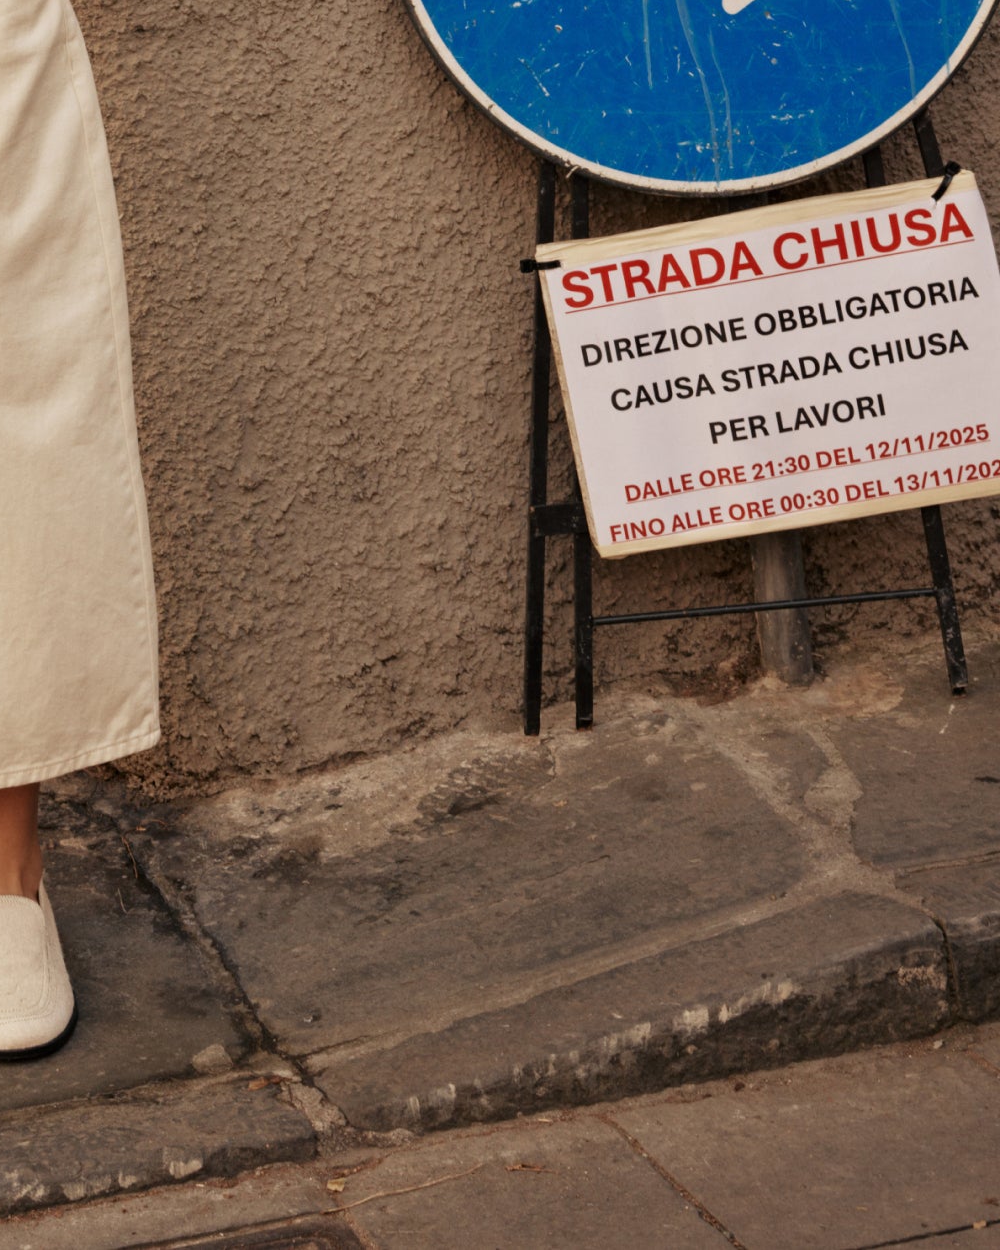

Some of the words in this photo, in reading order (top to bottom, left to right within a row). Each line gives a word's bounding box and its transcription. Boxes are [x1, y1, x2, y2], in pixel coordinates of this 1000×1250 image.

[562, 241, 763, 309] STRADA
[773, 203, 974, 271] CHIUSA
[581, 317, 747, 367] DIREZIONE
[754, 276, 980, 336] OBBLIGATORIA
[611, 373, 716, 412] CAUSA
[721, 352, 843, 393] STRADA
[848, 329, 969, 370] CHIUSA
[709, 415, 770, 445] PER
[775, 393, 886, 434] LAVORI
[624, 473, 695, 503] DALLE
[699, 465, 747, 488] ORE
[752, 454, 811, 481] 21:30
[815, 447, 861, 469] DEL
[866, 423, 990, 460] 12/11/2025
[610, 518, 666, 542] FINO
[672, 506, 723, 533] ALLE
[728, 498, 776, 521] ORE
[780, 487, 840, 513] 00:30
[845, 480, 890, 502] DEL
